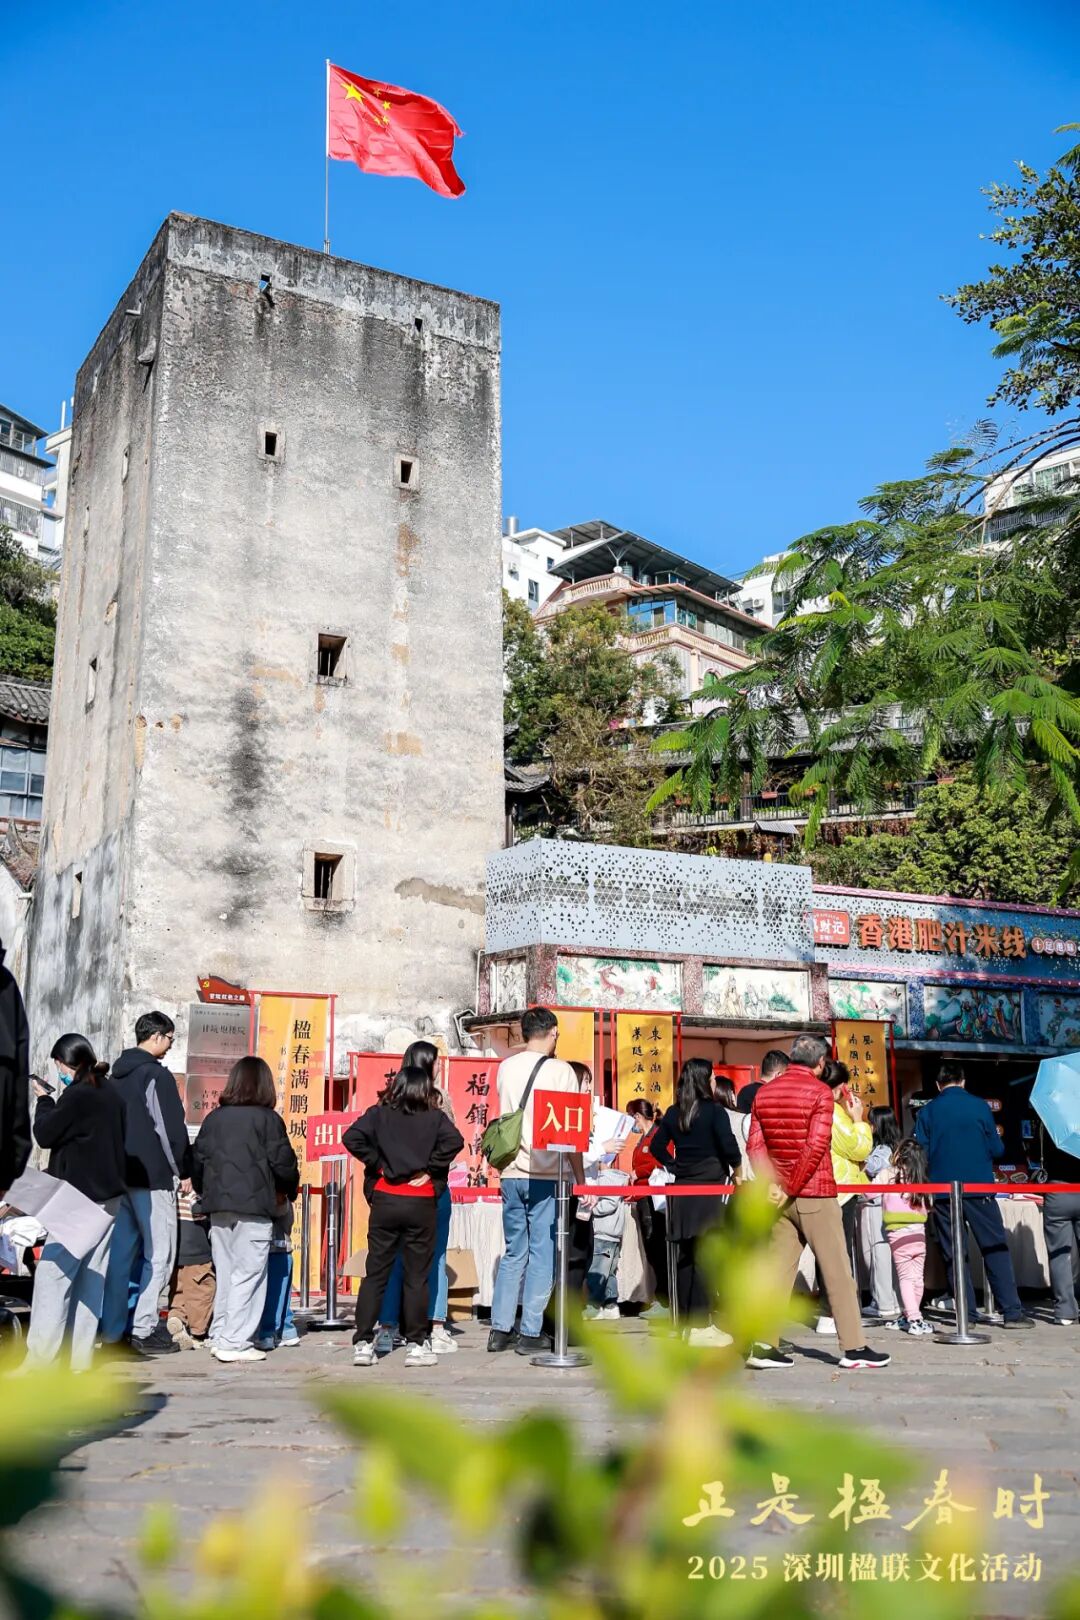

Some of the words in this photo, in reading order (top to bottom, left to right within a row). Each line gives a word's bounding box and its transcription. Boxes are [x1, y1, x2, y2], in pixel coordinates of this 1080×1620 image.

[857, 913, 1028, 959] 香港肥汁米线
[289, 1019, 312, 1140] 楹春满鹏城
[540, 1101, 584, 1133] 入口
